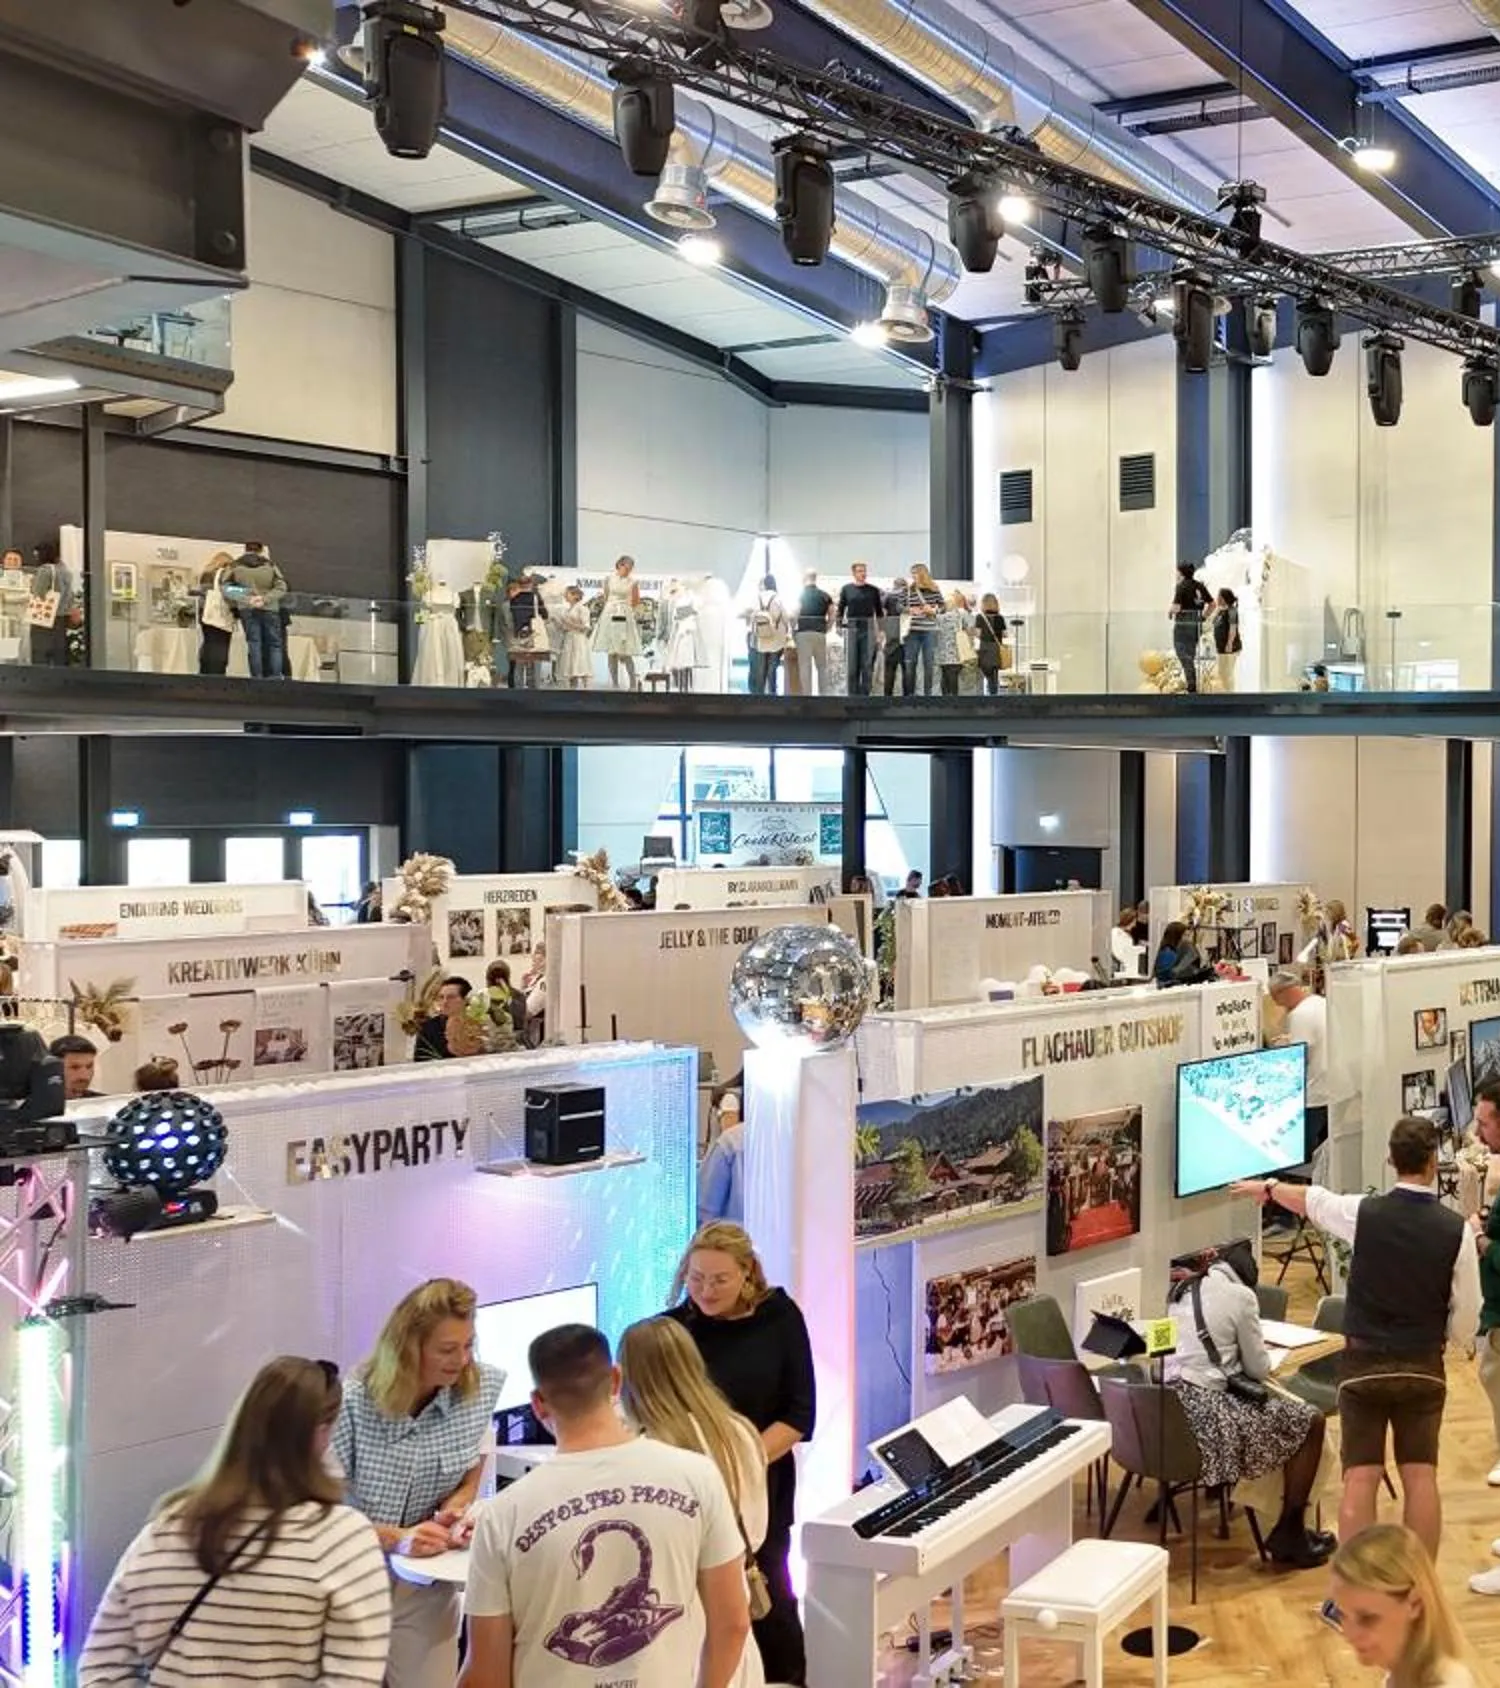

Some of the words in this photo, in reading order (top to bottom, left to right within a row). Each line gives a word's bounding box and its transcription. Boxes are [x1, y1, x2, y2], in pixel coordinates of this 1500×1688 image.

[120, 901, 178, 918] ENDURING
[483, 889, 538, 904] HERZREDEN
[660, 929, 693, 949] JELLY
[697, 930, 706, 947] &
[708, 928, 730, 946] THE
[168, 953, 291, 985] KREATIVWERK
[296, 950, 341, 976] KÜHN
[1021, 1025, 1115, 1069] FLACHAUER
[1119, 1012, 1184, 1051] GUTSHOF
[285, 1117, 470, 1186] EASYPARTY
[515, 1487, 626, 1553] DISTORTED
[629, 1485, 700, 1518] PEOPLE
